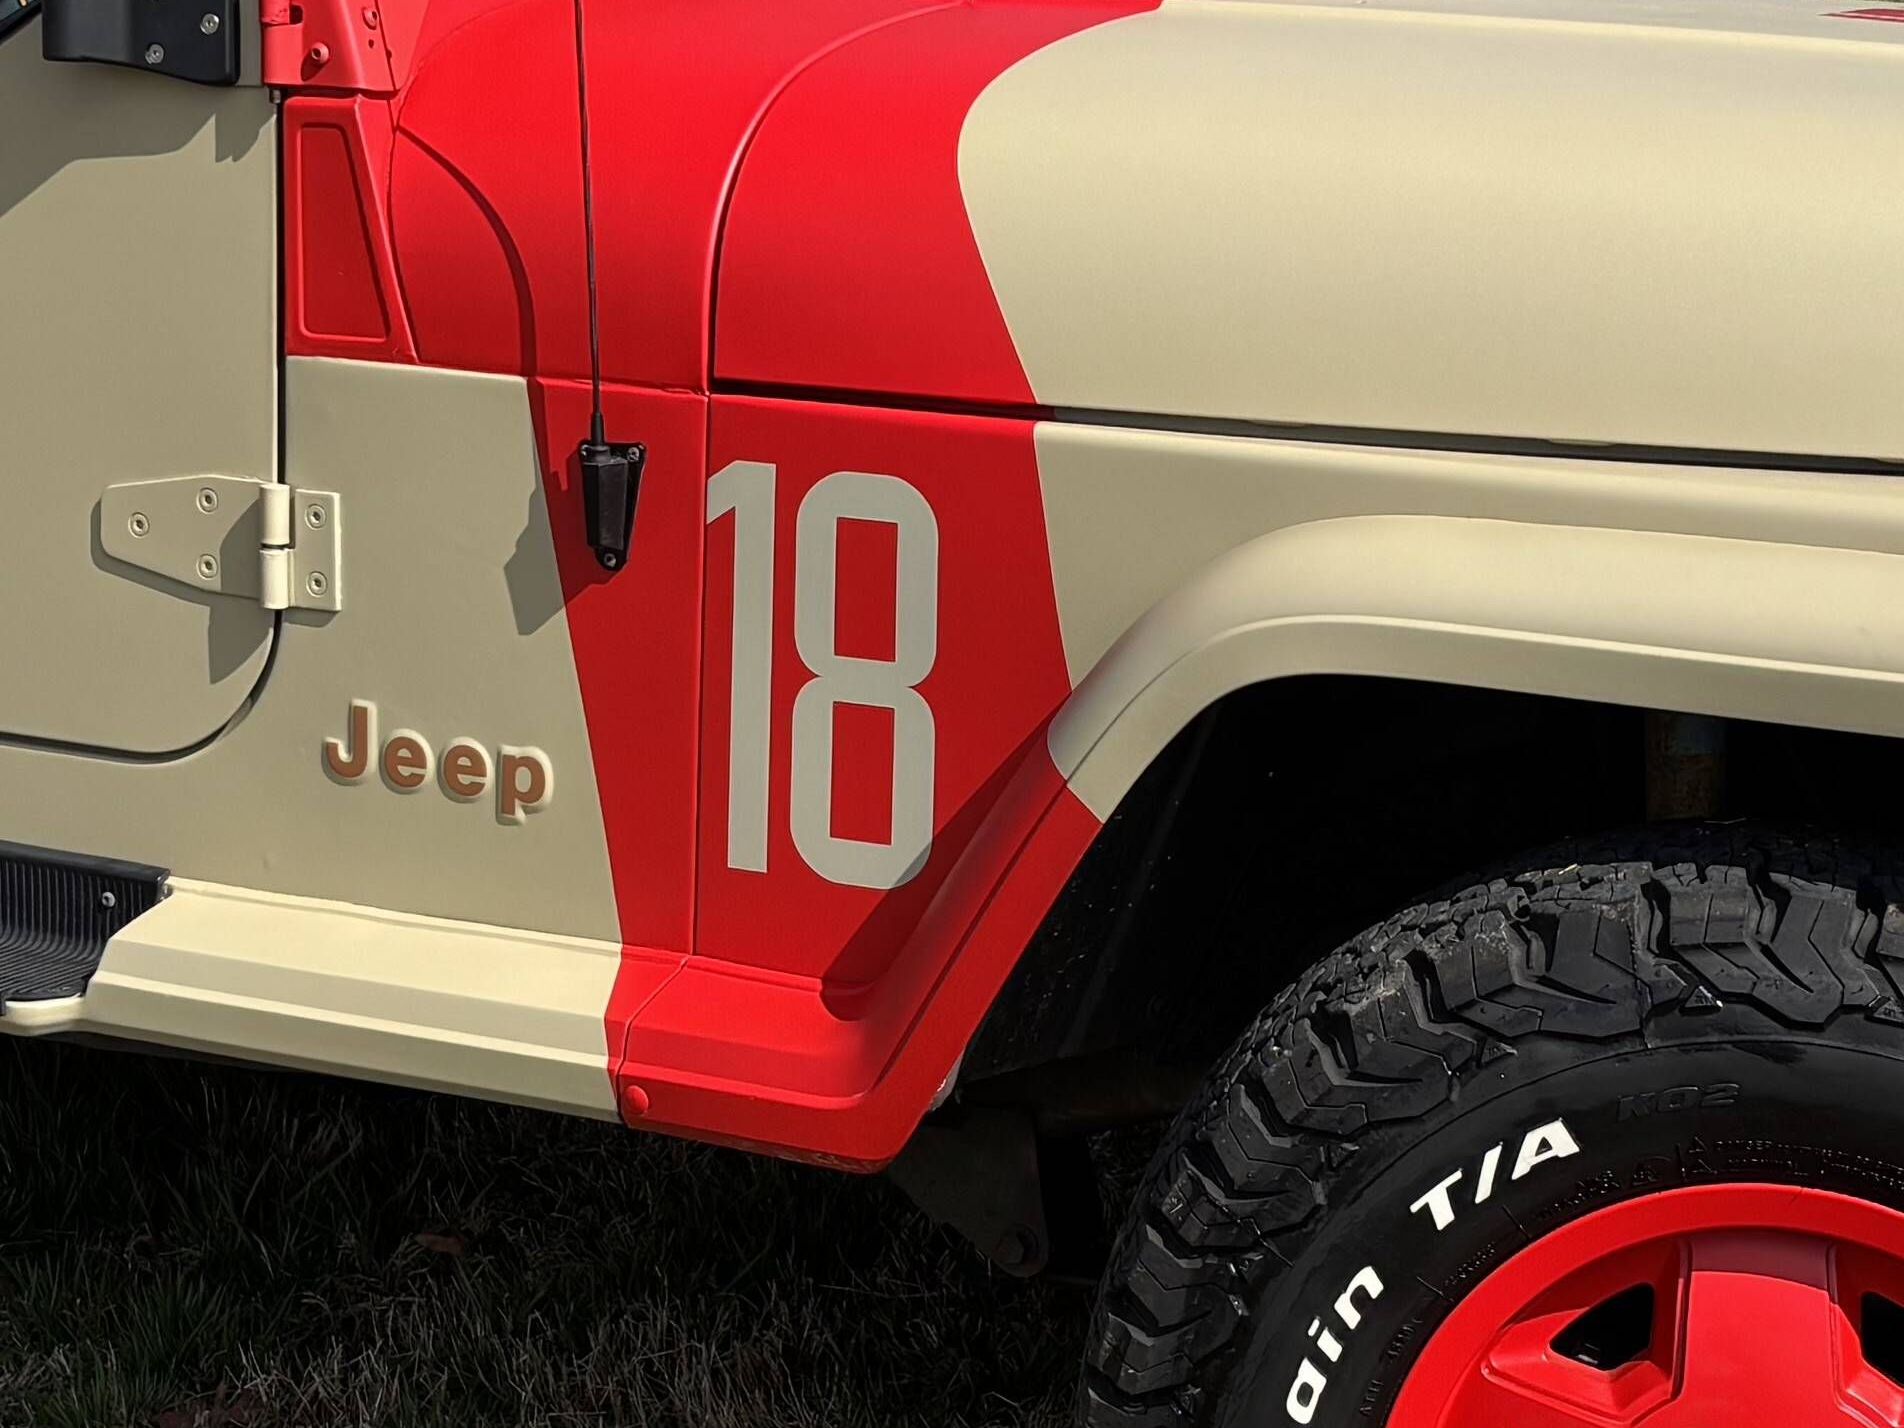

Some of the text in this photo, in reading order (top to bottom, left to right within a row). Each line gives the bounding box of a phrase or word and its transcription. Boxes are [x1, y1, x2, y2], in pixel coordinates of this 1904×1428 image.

[706, 460, 939, 890] 18
[322, 699, 553, 824] Jeep
[1409, 1117, 1580, 1232] T/A
